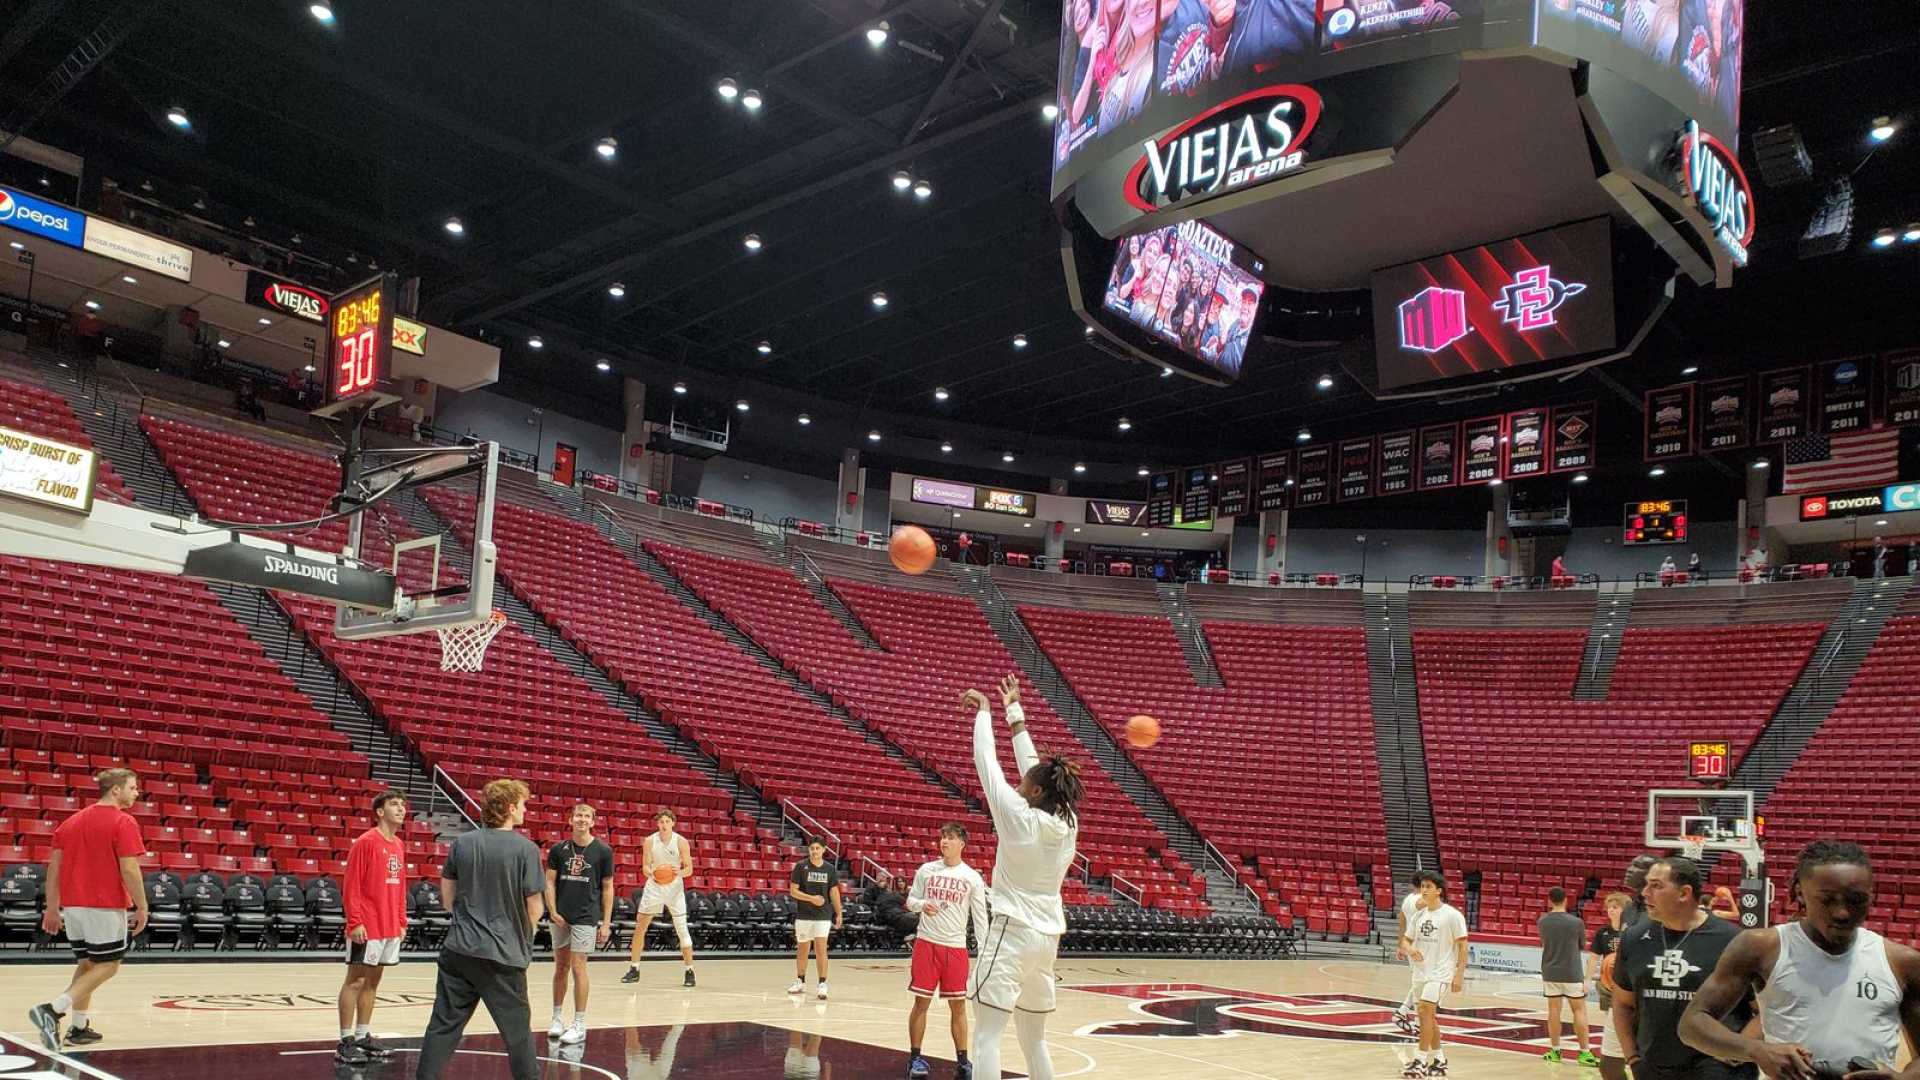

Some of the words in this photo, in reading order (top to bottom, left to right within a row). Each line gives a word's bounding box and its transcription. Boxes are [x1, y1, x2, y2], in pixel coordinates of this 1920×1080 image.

[1144, 101, 1293, 193] VIEJAS
[1228, 151, 1303, 187] arena
[1690, 119, 1747, 240] VIEJAS
[17, 206, 69, 232] pepsi
[156, 256, 190, 273] thrive
[273, 283, 321, 314] VIEJAS
[338, 290, 380, 337] 83:46
[339, 331, 374, 393] 30
[1832, 416, 1858, 430] 2011
[1894, 410, 1920, 422] 201
[1711, 435, 1736, 447] 2011
[1770, 427, 1796, 438] 2011
[30, 442, 67, 463] BURST
[67, 451, 83, 465] OF
[1383, 448, 1410, 460] WAC
[1655, 443, 1681, 454] 2010
[36, 479, 79, 500] FLAVOR
[1892, 485, 1920, 509] C
[1829, 496, 1881, 510] TOYOTA
[264, 554, 339, 585] SPALDING
[1692, 744, 1727, 756] 83:46
[1697, 756, 1722, 775] 30
[927, 875, 969, 893] AZTECS
[927, 887, 967, 905] ENERGY
[1655, 989, 1677, 999] DIEGO
[1678, 990, 1697, 1001] STA
[1856, 980, 1878, 1001] 10
